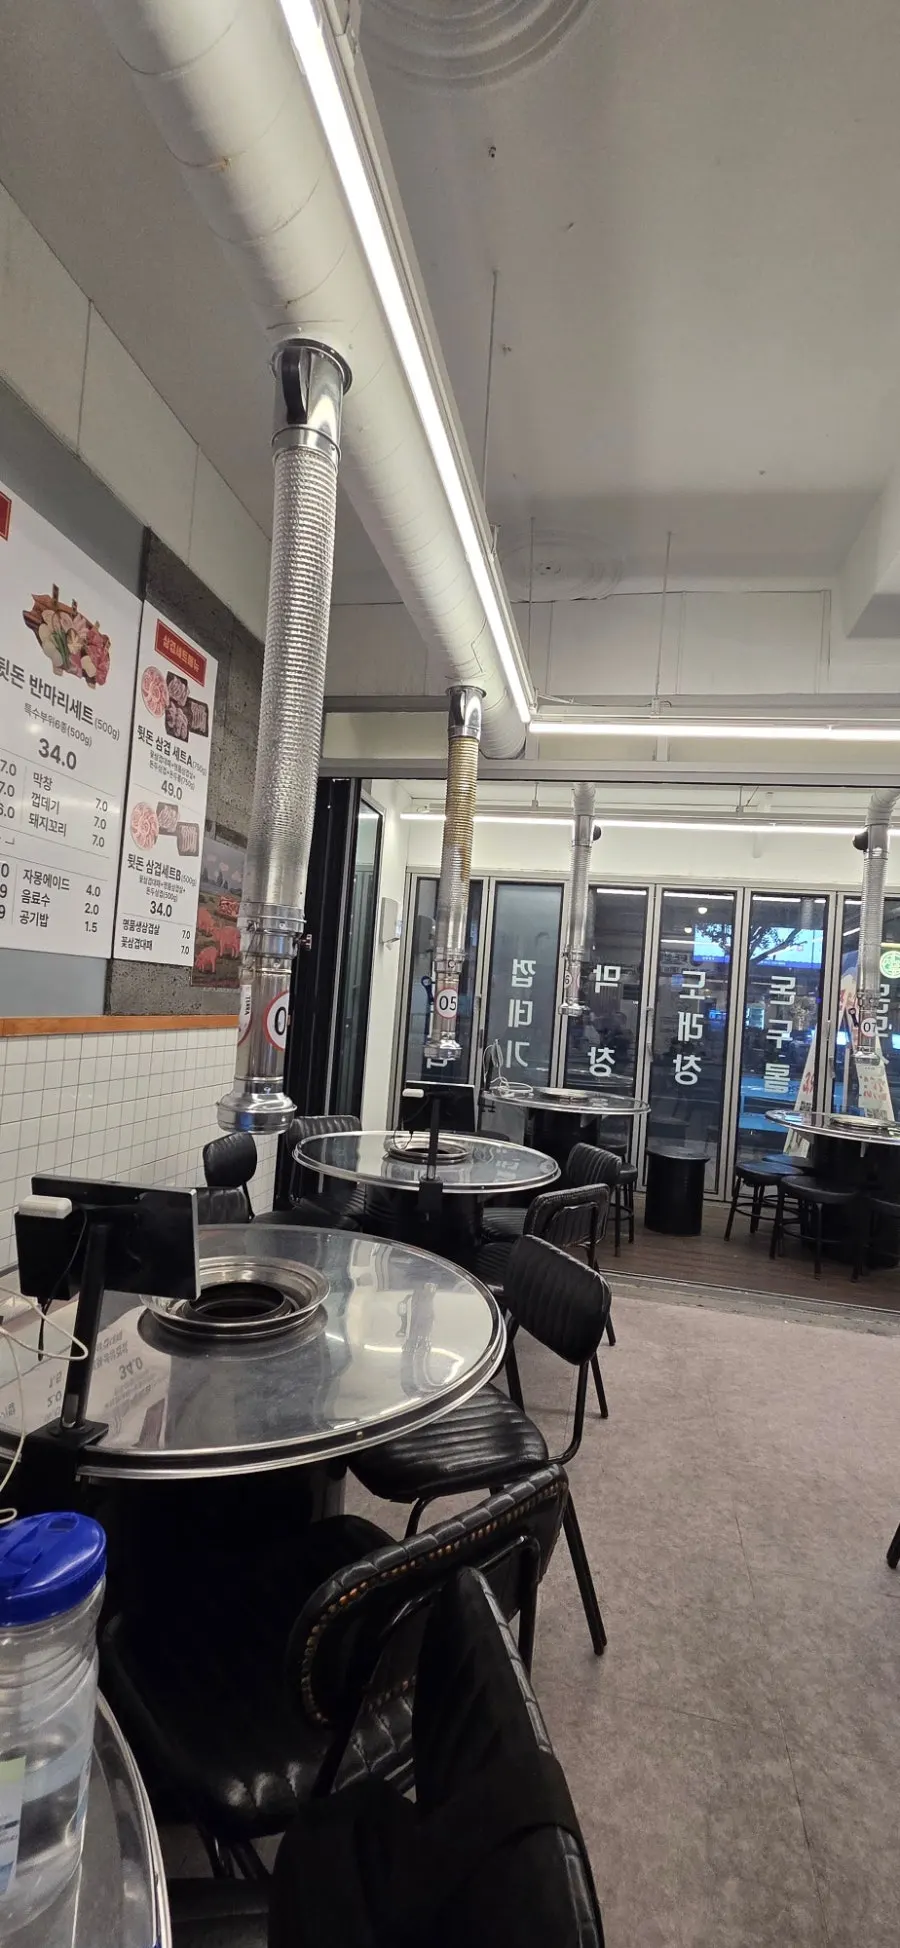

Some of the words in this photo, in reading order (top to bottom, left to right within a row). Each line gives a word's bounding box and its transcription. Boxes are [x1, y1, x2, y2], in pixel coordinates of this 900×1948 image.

[29, 674, 94, 726] 반마리세트
[94, 717, 120, 741] (500g)
[137, 724, 154, 747] 뒷돈
[156, 736, 171, 757] 삼겹
[38, 737, 77, 770] 34.0
[0, 759, 17, 777] 7.0
[33, 772, 53, 791] 막창
[95, 797, 108, 812] 7.0
[161, 780, 183, 800] 49.0
[31, 791, 60, 815] 껍데기
[94, 816, 107, 830] 7.0
[28, 812, 67, 837] 돼지꼬리
[92, 834, 105, 848] 7.0
[127, 853, 144, 872] 뒷돈
[22, 869, 70, 891] 자몽에이드
[85, 884, 101, 897] 4.0
[21, 888, 51, 907] 음료수
[84, 902, 99, 915] 2.0
[150, 900, 172, 917] 34.0
[19, 909, 49, 928] 공기밥
[84, 921, 98, 933] 1.5
[123, 919, 160, 936] 명품생삼겹살
[181, 929, 191, 940] 7.0
[121, 936, 153, 951] 꽃삼겹대패
[180, 945, 190, 955] 7.0
[439, 996, 457, 1011] 05
[863, 1022, 877, 1033] 07
